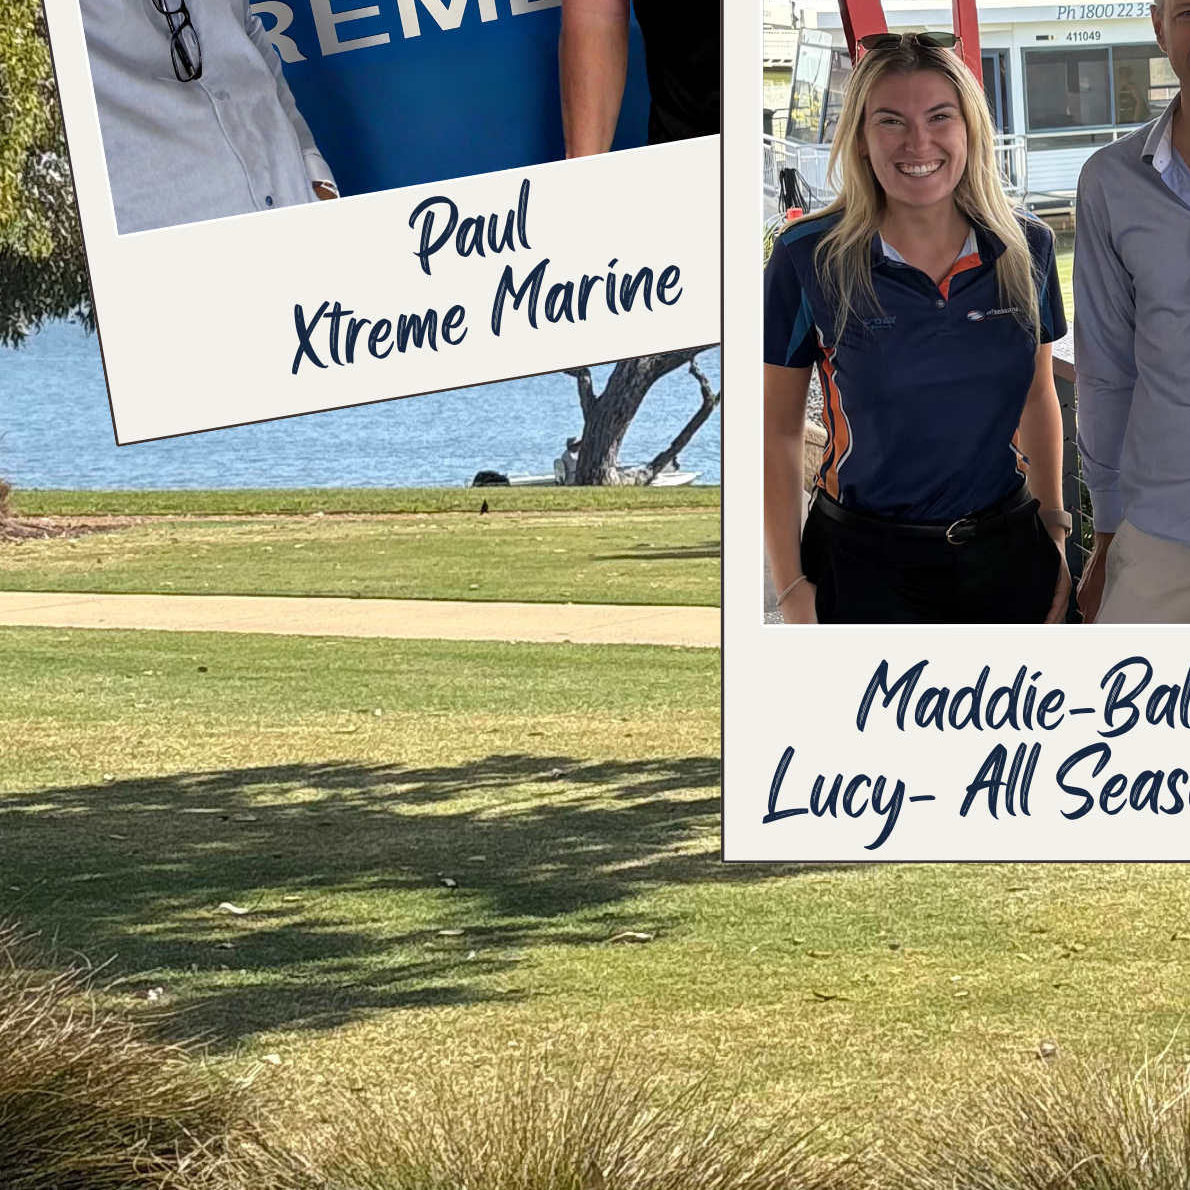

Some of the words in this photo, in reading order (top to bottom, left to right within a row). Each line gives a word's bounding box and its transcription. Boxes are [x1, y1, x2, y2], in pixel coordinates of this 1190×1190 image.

[1056, 5, 1076, 20] Ph
[1079, 4, 1115, 19] 1800
[1116, 3, 1134, 18] 22
[1066, 31, 1101, 42] 411049
